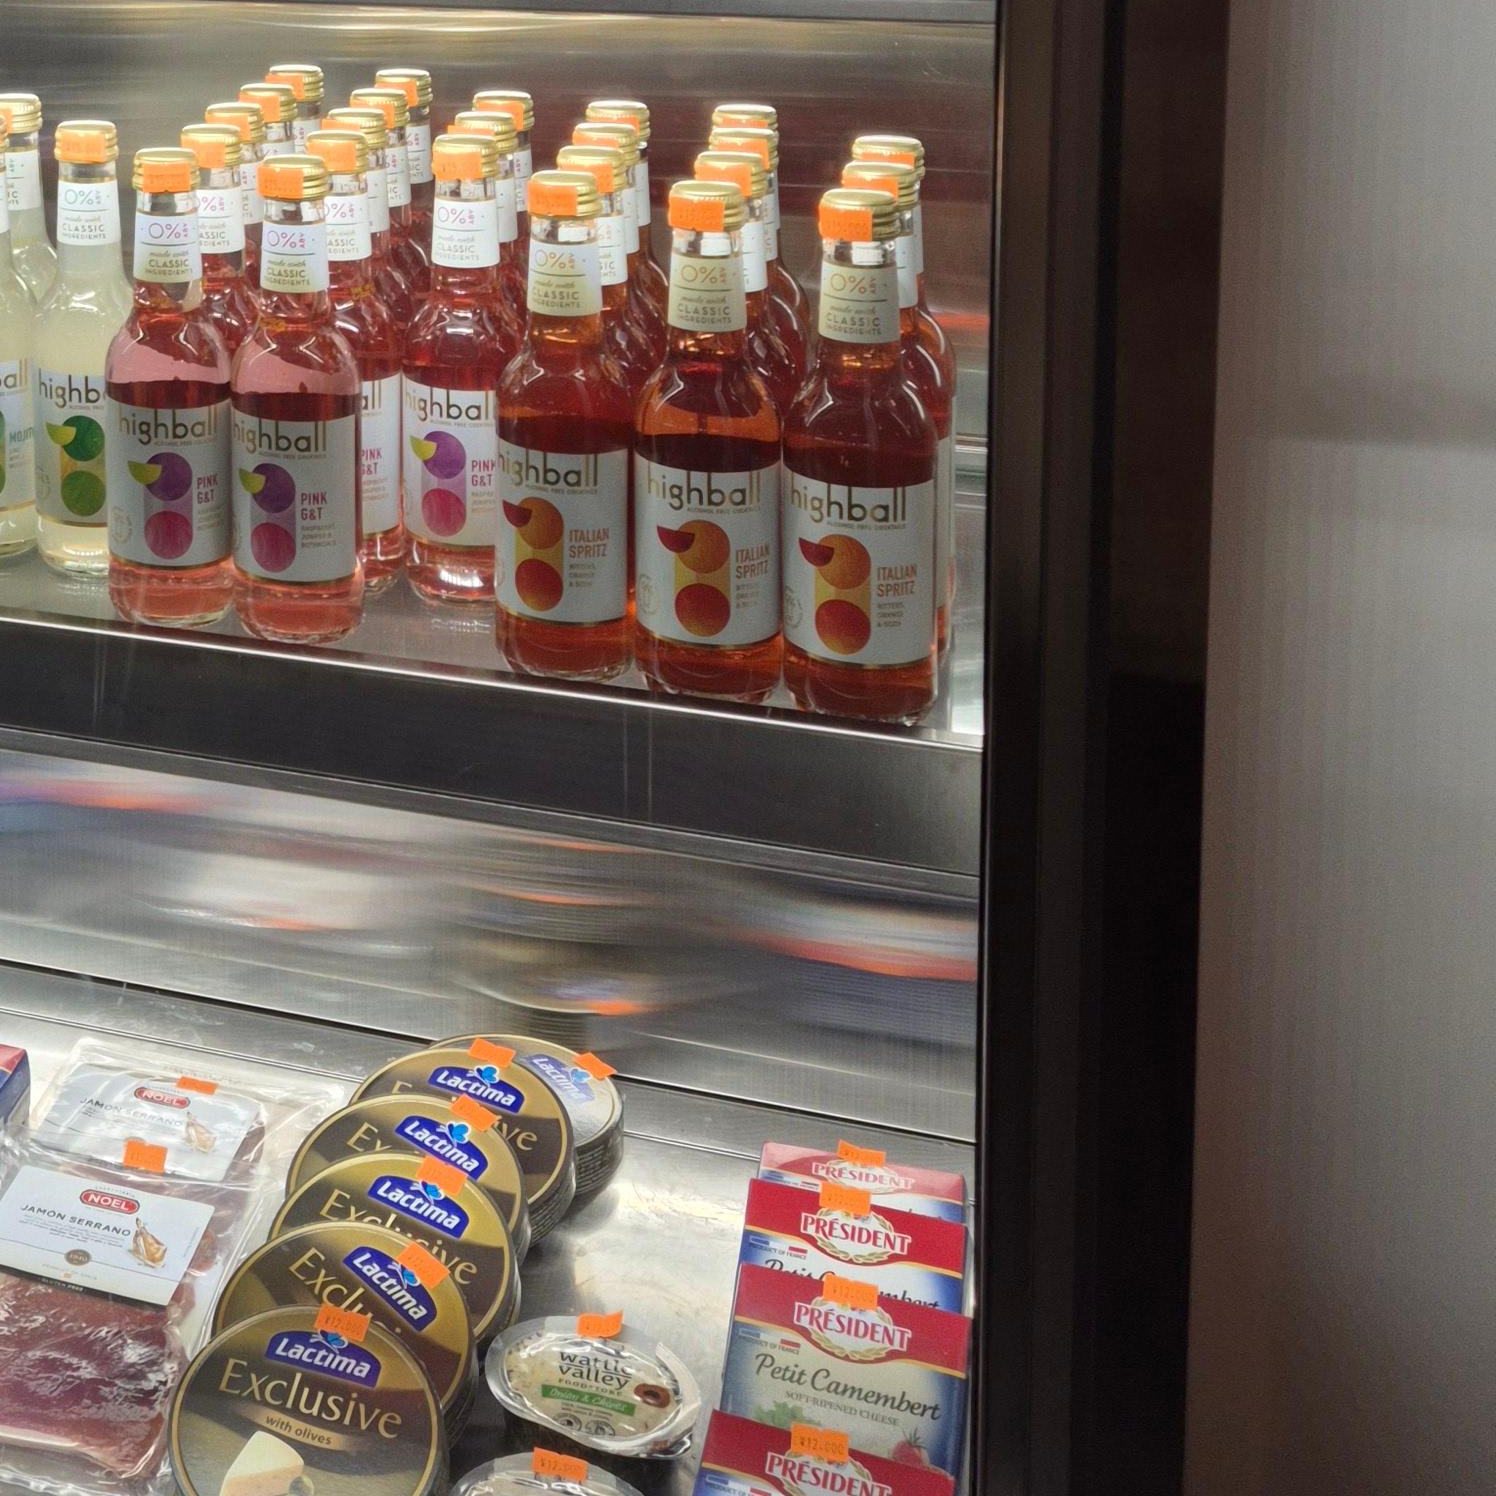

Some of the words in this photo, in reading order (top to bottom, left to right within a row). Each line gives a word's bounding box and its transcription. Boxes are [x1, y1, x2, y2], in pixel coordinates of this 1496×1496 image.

[437, 206, 466, 224] 0%
[62, 222, 105, 233] CLASSIC
[148, 221, 181, 240] 0%
[267, 230, 297, 248] 0%
[437, 243, 476, 254] CLASSIC
[148, 259, 190, 269] CLASSIC
[266, 269, 307, 279] CLASSIC
[680, 264, 718, 284] 0%
[829, 272, 866, 295] 0%
[532, 289, 580, 300] CLASSIC
[676, 303, 730, 316] CLASSIC
[825, 313, 881, 327] CLASSIC
[118, 404, 218, 446] highball
[232, 418, 327, 454] highball
[496, 448, 598, 487] highball
[196, 473, 218, 490] PINK
[471, 473, 493, 487] G&T
[647, 460, 761, 511] highball
[197, 489, 215, 504] G&T
[300, 492, 328, 505] PINK
[791, 472, 907, 523] highball
[300, 508, 323, 521] G&T
[568, 528, 610, 544] ITALIAN
[568, 543, 607, 559] SPRITZ
[735, 543, 770, 563] ITALIAN
[735, 561, 769, 580] SPRITZ
[877, 563, 918, 581] ITALIAN
[877, 581, 915, 598] SPRITZ
[434, 1069, 517, 1108] Lactima
[403, 1119, 481, 1173] Lactima
[813, 1163, 915, 1190] PRÉSIDENT
[87, 1192, 130, 1212] NOEL
[375, 1179, 462, 1230] Lactima
[21, 1204, 66, 1221] JAMÓN
[68, 1215, 132, 1238] SERRANO
[803, 1214, 911, 1254] PRÉSIDENT
[351, 1251, 428, 1321] Lactima
[795, 1303, 911, 1351] PRÉSIDENT
[275, 1337, 372, 1379] Lactima
[558, 1364, 631, 1392] valley
[755, 1352, 807, 1385] Petit
[810, 1367, 942, 1422] Camembert
[218, 1357, 403, 1440] Exclusive
[858, 1407, 901, 1427] CHEESE
[265, 1413, 292, 1432] with
[293, 1426, 333, 1447] olives
[767, 1453, 892, 1496] PRÉSIDENT
